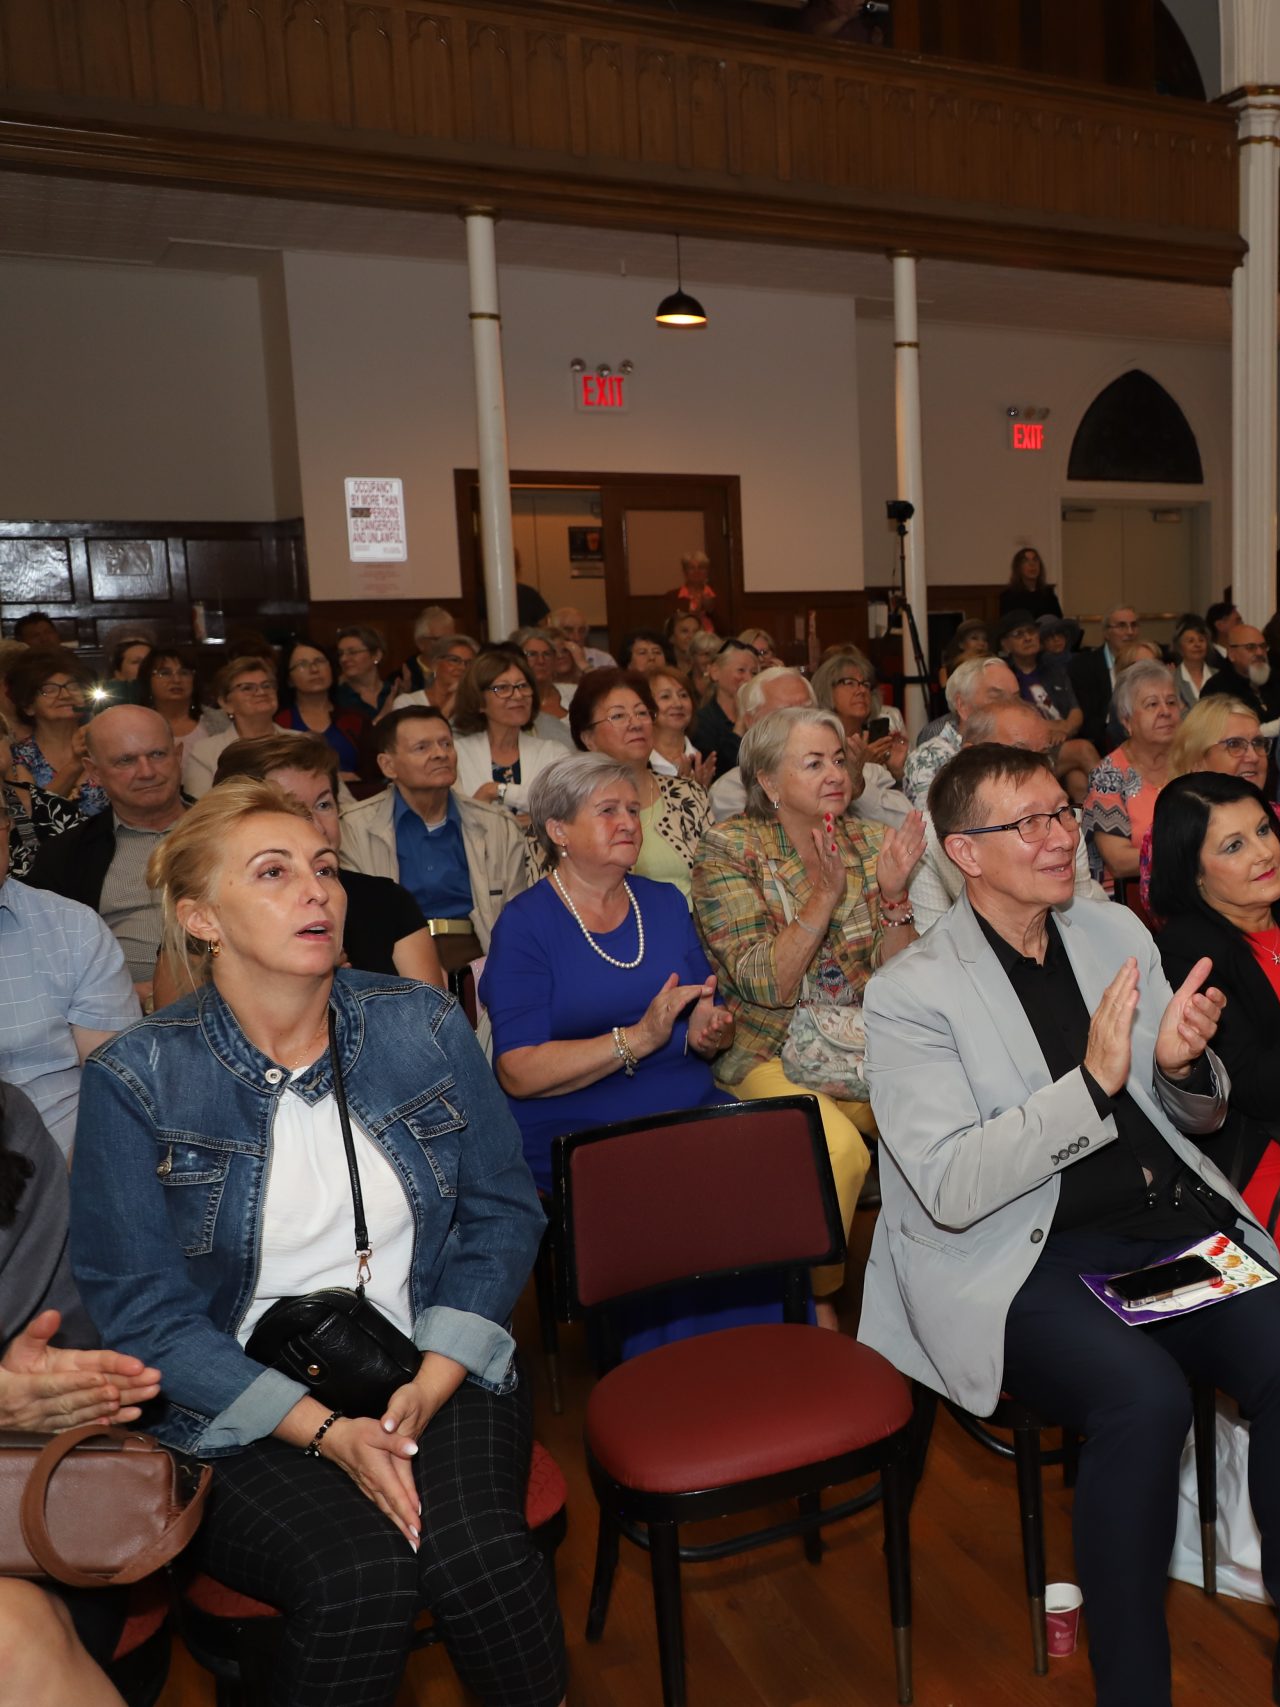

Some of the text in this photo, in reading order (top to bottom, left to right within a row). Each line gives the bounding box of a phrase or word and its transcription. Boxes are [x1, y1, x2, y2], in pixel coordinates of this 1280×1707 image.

[582, 376, 624, 407] EXIT
[1013, 424, 1043, 449] EXIT
[354, 481, 393, 494] OCCUPANCY
[351, 495, 399, 506] BY MORE THAN
[370, 507, 399, 519] PERSONS
[352, 520, 400, 531] IS DANGEROUS
[352, 532, 402, 543] AND UNLAWFUL
